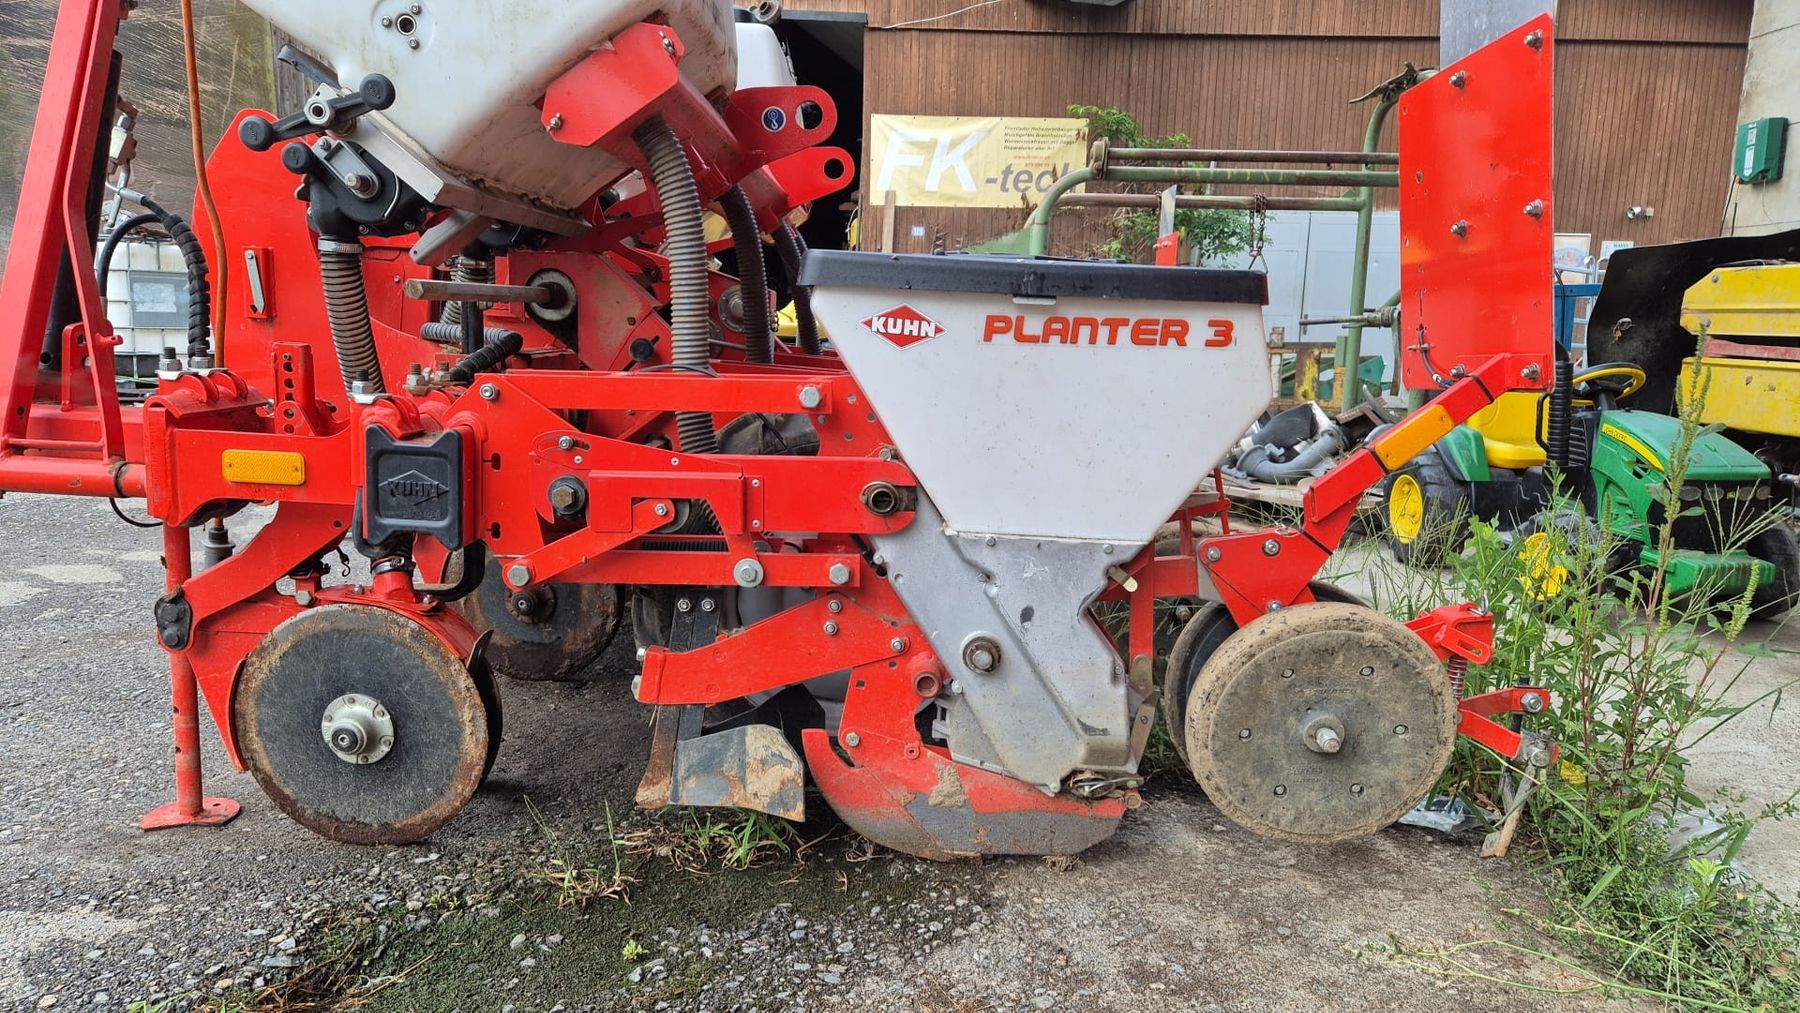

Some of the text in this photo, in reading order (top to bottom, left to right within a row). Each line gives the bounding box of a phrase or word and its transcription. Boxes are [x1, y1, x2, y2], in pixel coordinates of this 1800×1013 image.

[871, 315, 936, 337] KUHN
[983, 315, 1234, 347] PLANTER 3
[387, 480, 440, 498] KUHN
